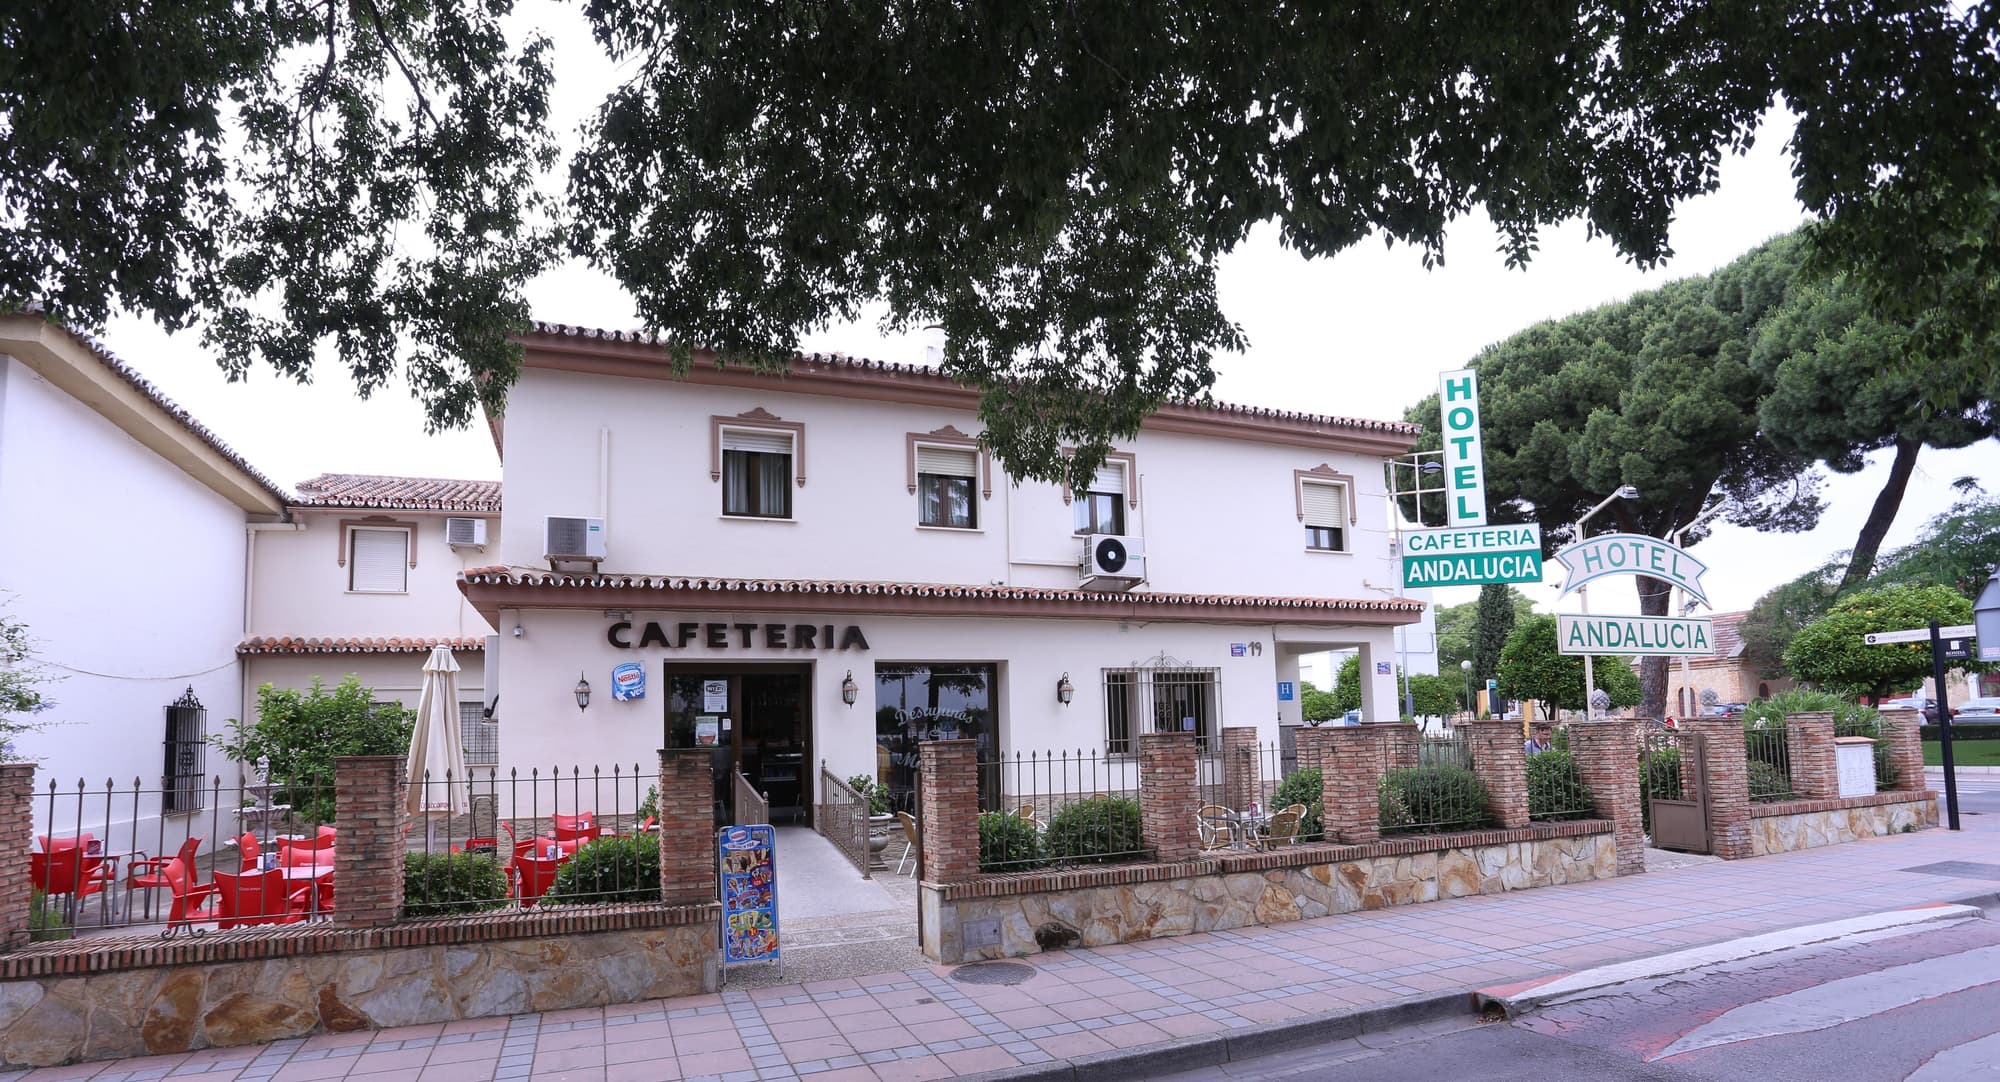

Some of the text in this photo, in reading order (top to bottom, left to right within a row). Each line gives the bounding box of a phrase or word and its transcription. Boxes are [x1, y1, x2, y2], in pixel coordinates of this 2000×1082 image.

[1446, 377, 1479, 519] HOTEL
[1408, 529, 1536, 551] CAFETERIA
[1407, 555, 1538, 583] ANDALUCIA
[1582, 542, 1687, 581] HOTEL
[607, 622, 870, 651] CAFETERIA
[1568, 620, 1709, 649] ANDALUCIA
[1247, 641, 1262, 657] 19
[1281, 683, 1290, 695] H
[894, 706, 974, 726] Desayunos
